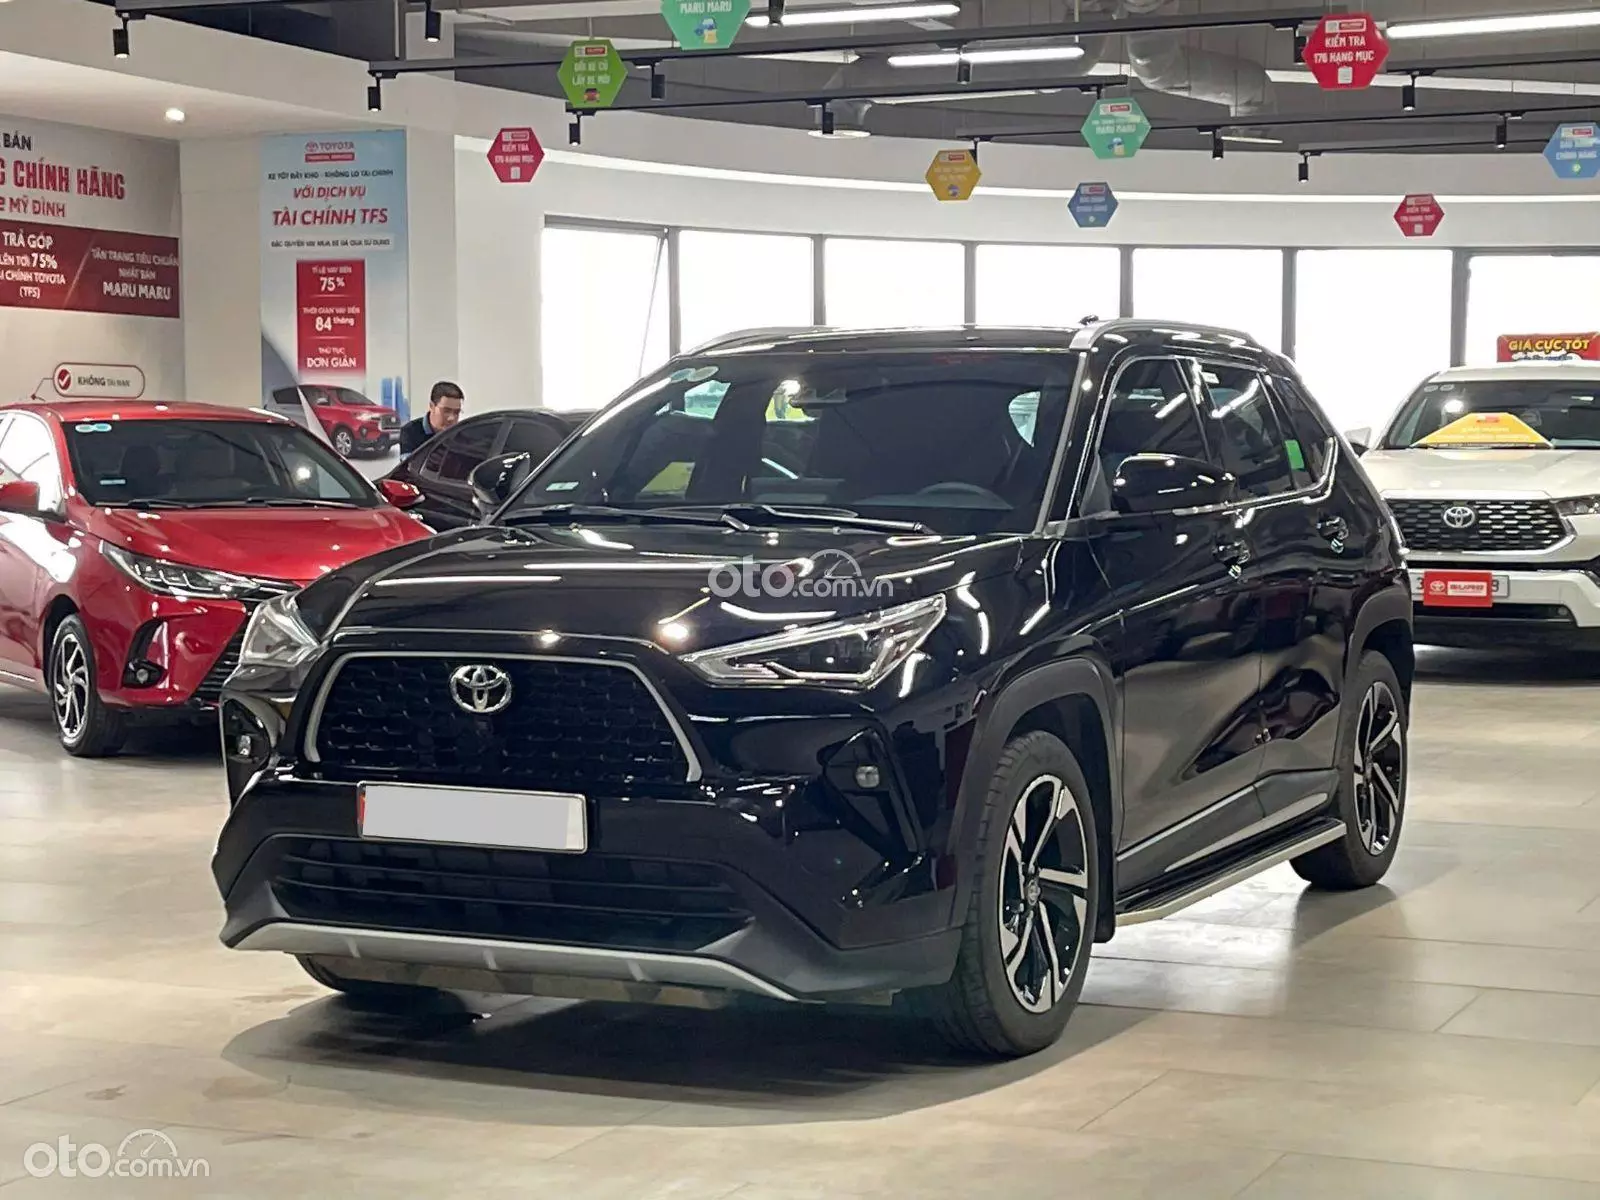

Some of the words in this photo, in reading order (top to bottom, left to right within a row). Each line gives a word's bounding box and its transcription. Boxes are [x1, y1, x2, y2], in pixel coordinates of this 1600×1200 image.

[680, 2, 705, 14] MARU
[707, 0, 732, 12] MARU
[1348, 35, 1366, 46] TRA
[320, 141, 355, 150] TOYOTA
[13, 157, 70, 193] CHÍNH
[76, 166, 126, 200] HÃNG
[293, 185, 315, 199] VỚI
[317, 186, 347, 202] DỊCH
[9, 195, 28, 214] MỸ
[32, 196, 65, 217] ĐÌNH
[272, 206, 298, 226] TÀI
[301, 204, 356, 226] CHÍNH
[361, 208, 388, 225] TFS
[2, 229, 26, 248] TRẢ
[27, 231, 54, 249] GÓP
[31, 252, 58, 269] 75%
[33, 271, 66, 284] TOYOTA
[20, 286, 41, 299] (TFS)
[102, 281, 137, 298] MARU
[138, 284, 171, 300] MARU
[315, 316, 332, 331] 84
[330, 354, 357, 368] GIẢN
[78, 375, 106, 387] KHÔNG
